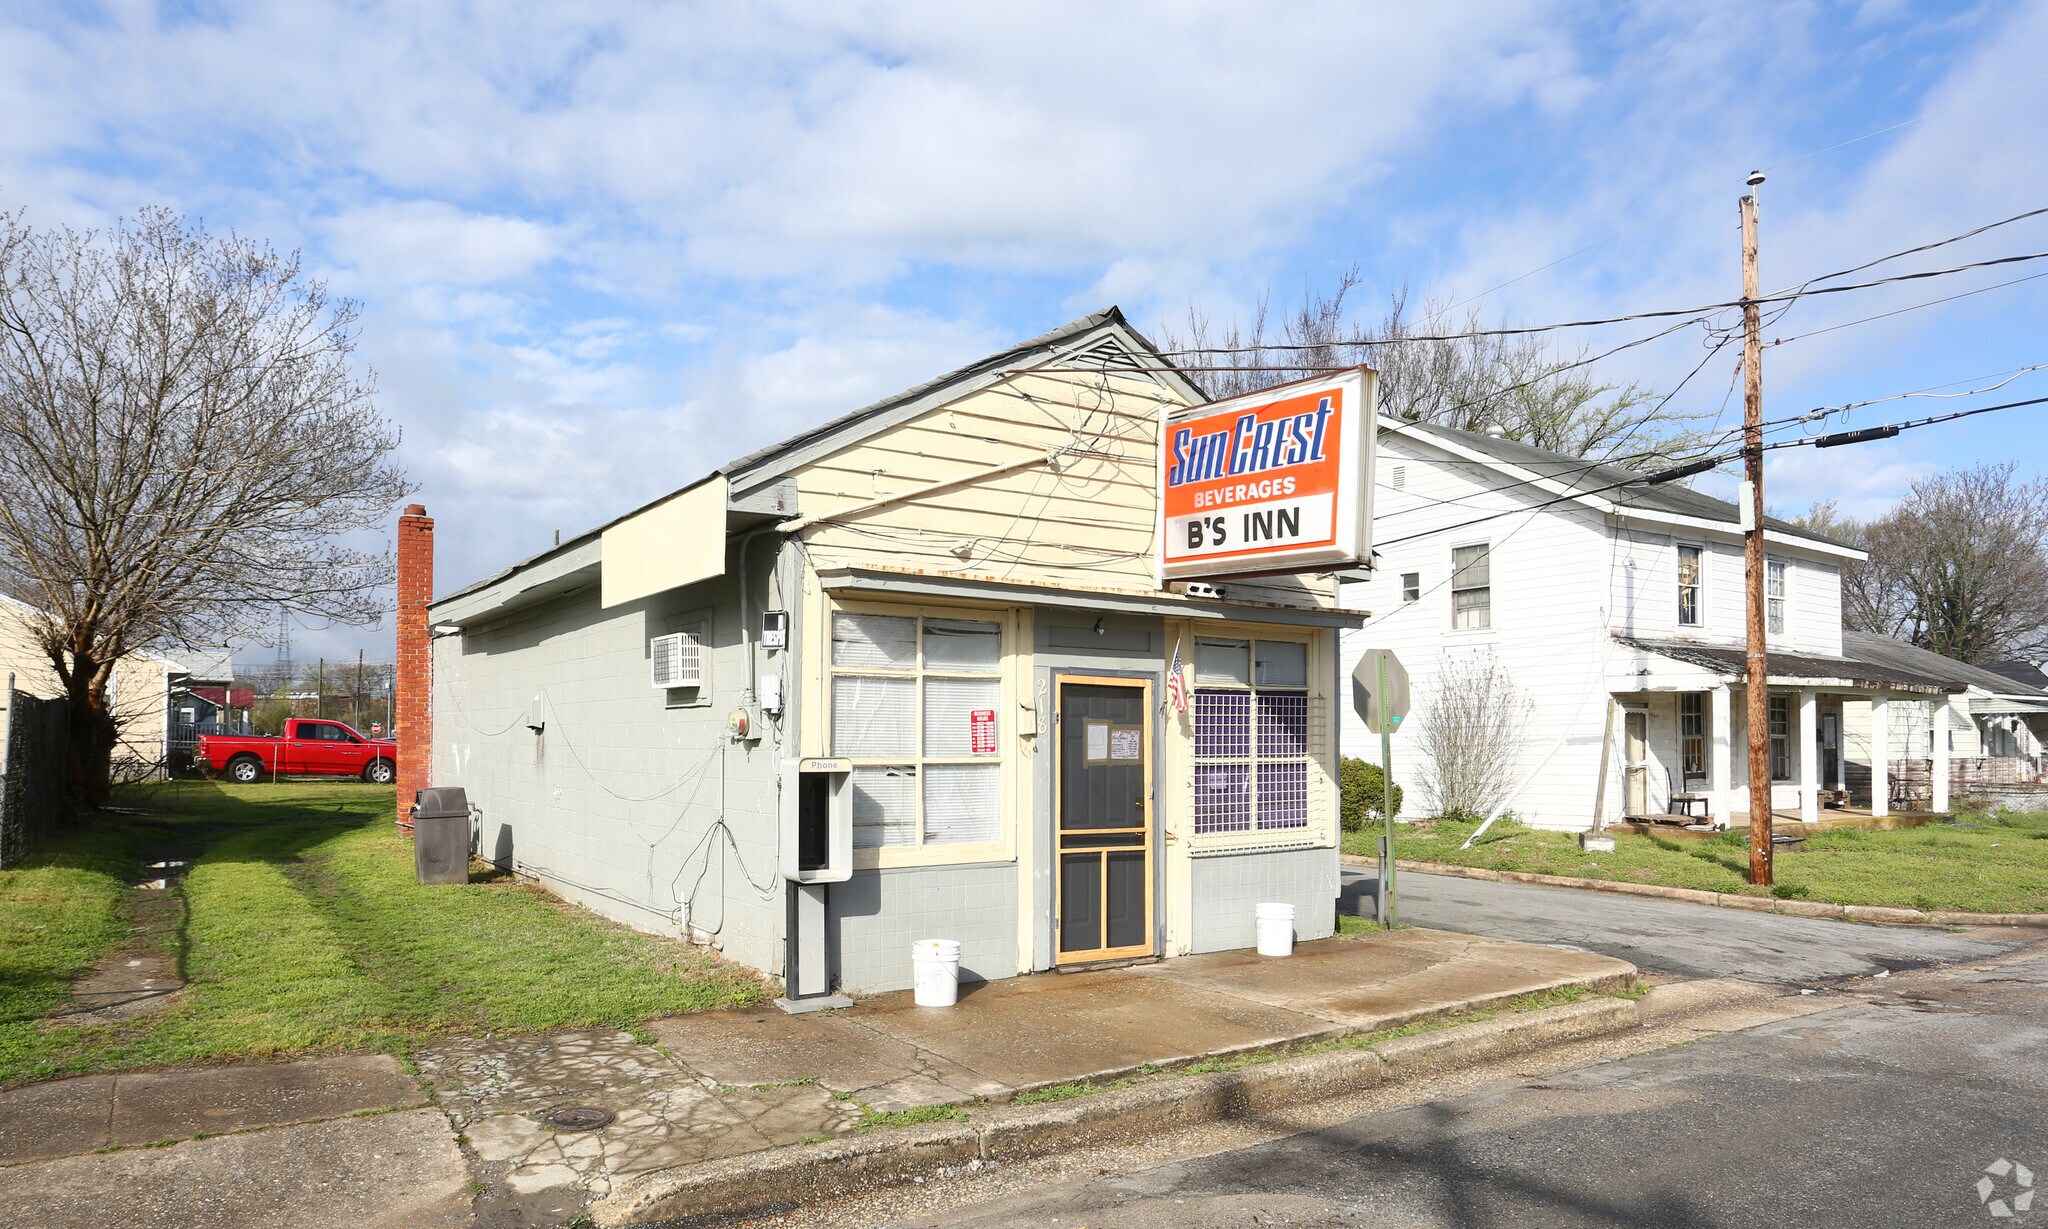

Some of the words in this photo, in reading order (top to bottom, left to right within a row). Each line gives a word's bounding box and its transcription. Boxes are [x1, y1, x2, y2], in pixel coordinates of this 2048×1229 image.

[1194, 476, 1296, 508] BEVERAGES
[1187, 516, 1227, 549] B'S
[1243, 507, 1300, 542] INN
[811, 761, 838, 769] Phone
